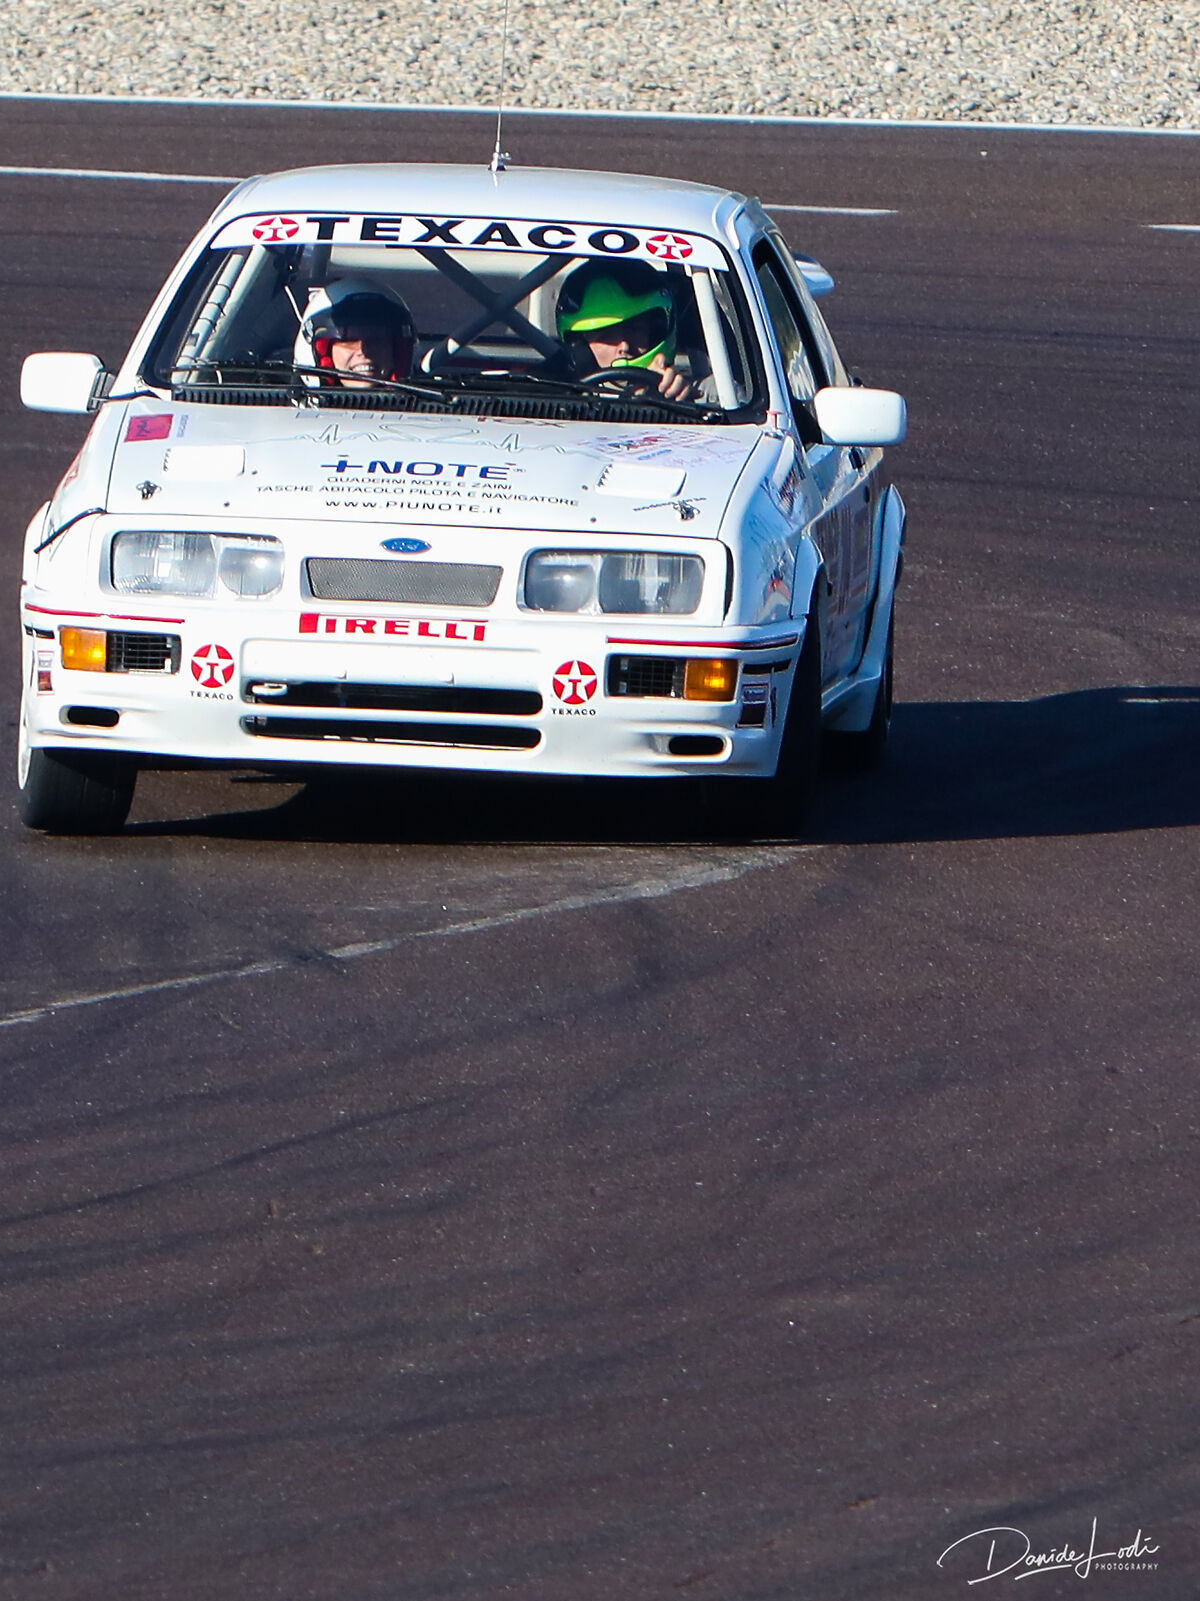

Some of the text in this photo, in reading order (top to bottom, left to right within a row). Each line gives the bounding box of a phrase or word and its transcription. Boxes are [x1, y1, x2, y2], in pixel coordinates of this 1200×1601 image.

[307, 217, 641, 254] TEXACO
[326, 476, 406, 485] QUADERNI
[410, 479, 451, 487] NOTE
[471, 483, 513, 491] ZAINI
[256, 485, 314, 494] TASCHE
[319, 486, 404, 495] ABITACOLO
[409, 488, 462, 497] PILOTA
[481, 492, 580, 507] NAVIGATORE
[190, 690, 234, 701] TEXACO
[552, 707, 596, 716] TEXACO
